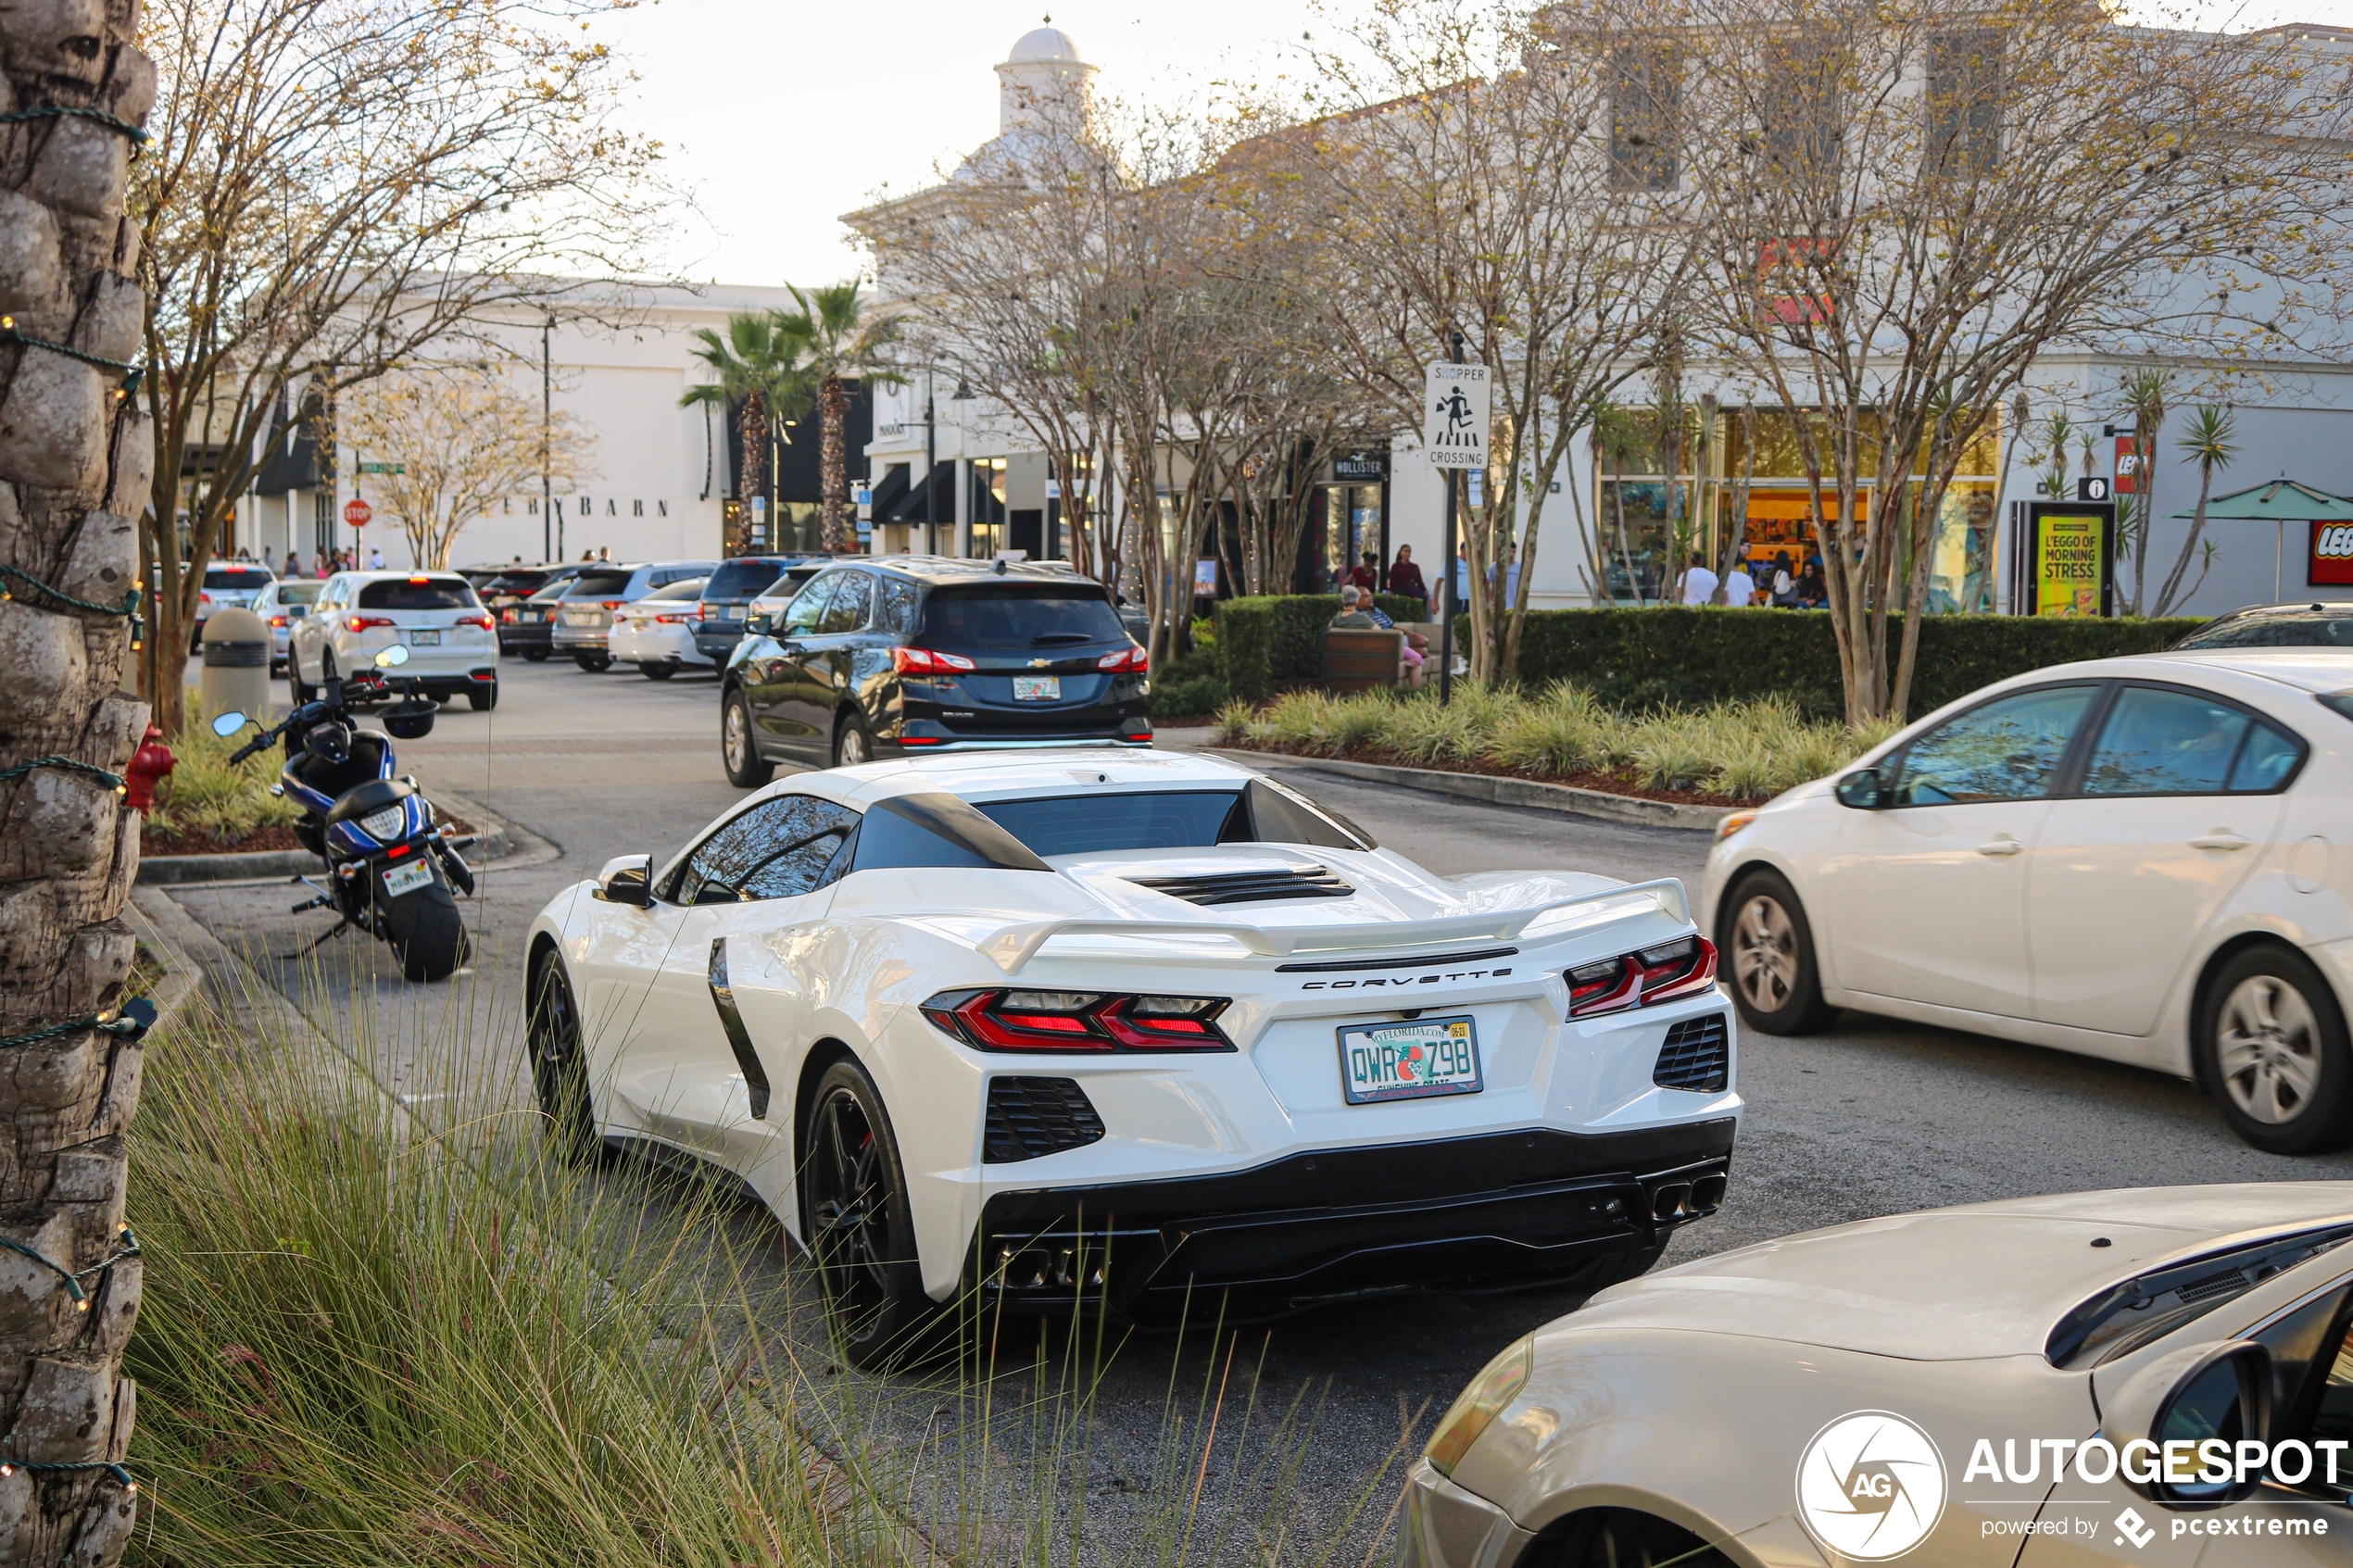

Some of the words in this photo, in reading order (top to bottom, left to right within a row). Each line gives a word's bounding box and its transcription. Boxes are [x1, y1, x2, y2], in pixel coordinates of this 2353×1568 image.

[1435, 368, 1484, 380] SHOPPER
[1430, 451, 1482, 464] CROSSING
[1337, 461, 1382, 473] HOLLISTER
[581, 496, 668, 517] BARN
[346, 508, 369, 520] STOP
[2045, 536, 2081, 547] L'EGGO
[2082, 536, 2096, 547] OF
[2045, 549, 2096, 561] MORNING
[2045, 562, 2097, 578] STRESS.
[1302, 968, 1512, 989] CORVETTE
[1352, 1046, 1397, 1083] QWR
[1425, 1039, 1470, 1077] Z98
